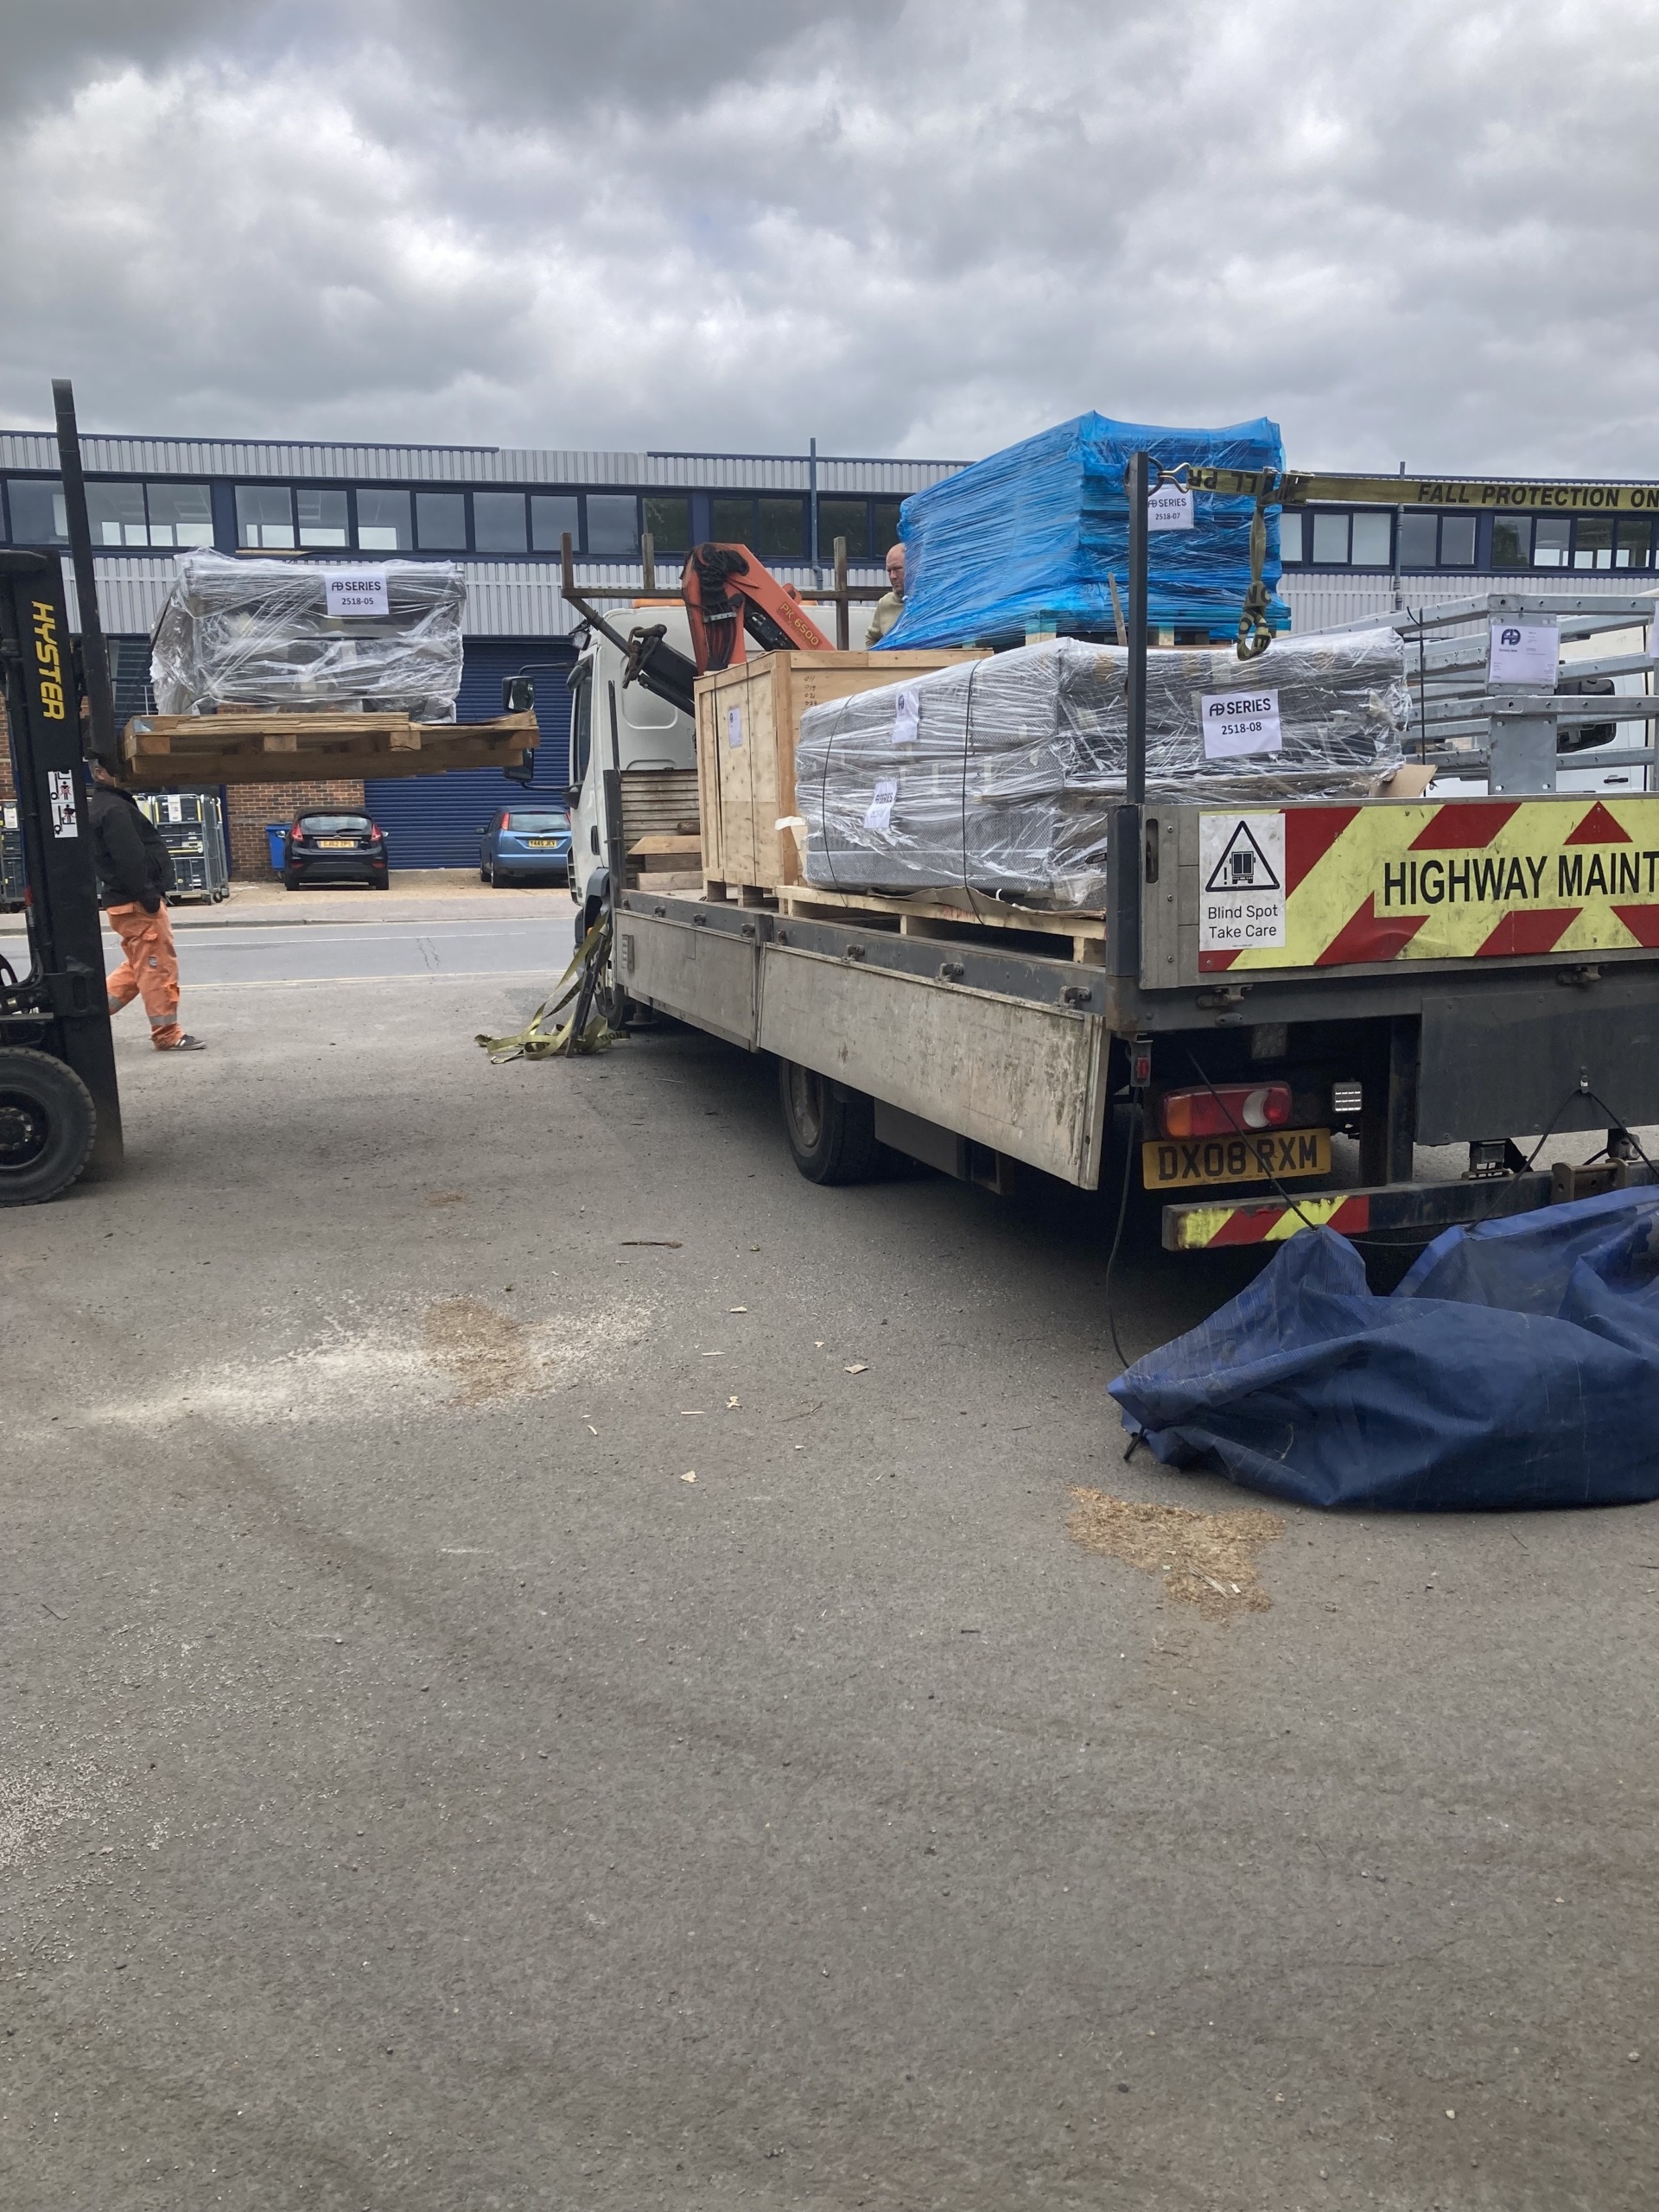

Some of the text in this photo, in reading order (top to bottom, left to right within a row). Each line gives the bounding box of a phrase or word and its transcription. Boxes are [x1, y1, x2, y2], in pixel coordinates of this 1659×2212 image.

[1418, 483, 1470, 503] FALL
[1481, 485, 1620, 506] PROTECTION
[1159, 499, 1187, 508] SERIES
[346, 582, 381, 591] SERIES
[341, 597, 374, 606] 2518-05
[780, 602, 795, 619] PK
[794, 618, 819, 645] 6500
[31, 601, 65, 720] HYSTER
[1226, 698, 1271, 715] SERIES
[1221, 721, 1262, 734] 2518-08
[1384, 855, 1548, 906] HIGHWAY
[1208, 904, 1279, 920] Blind Spot
[1209, 925, 1277, 938] Take Care
[1158, 1135, 1318, 1181] DX08 RXM
